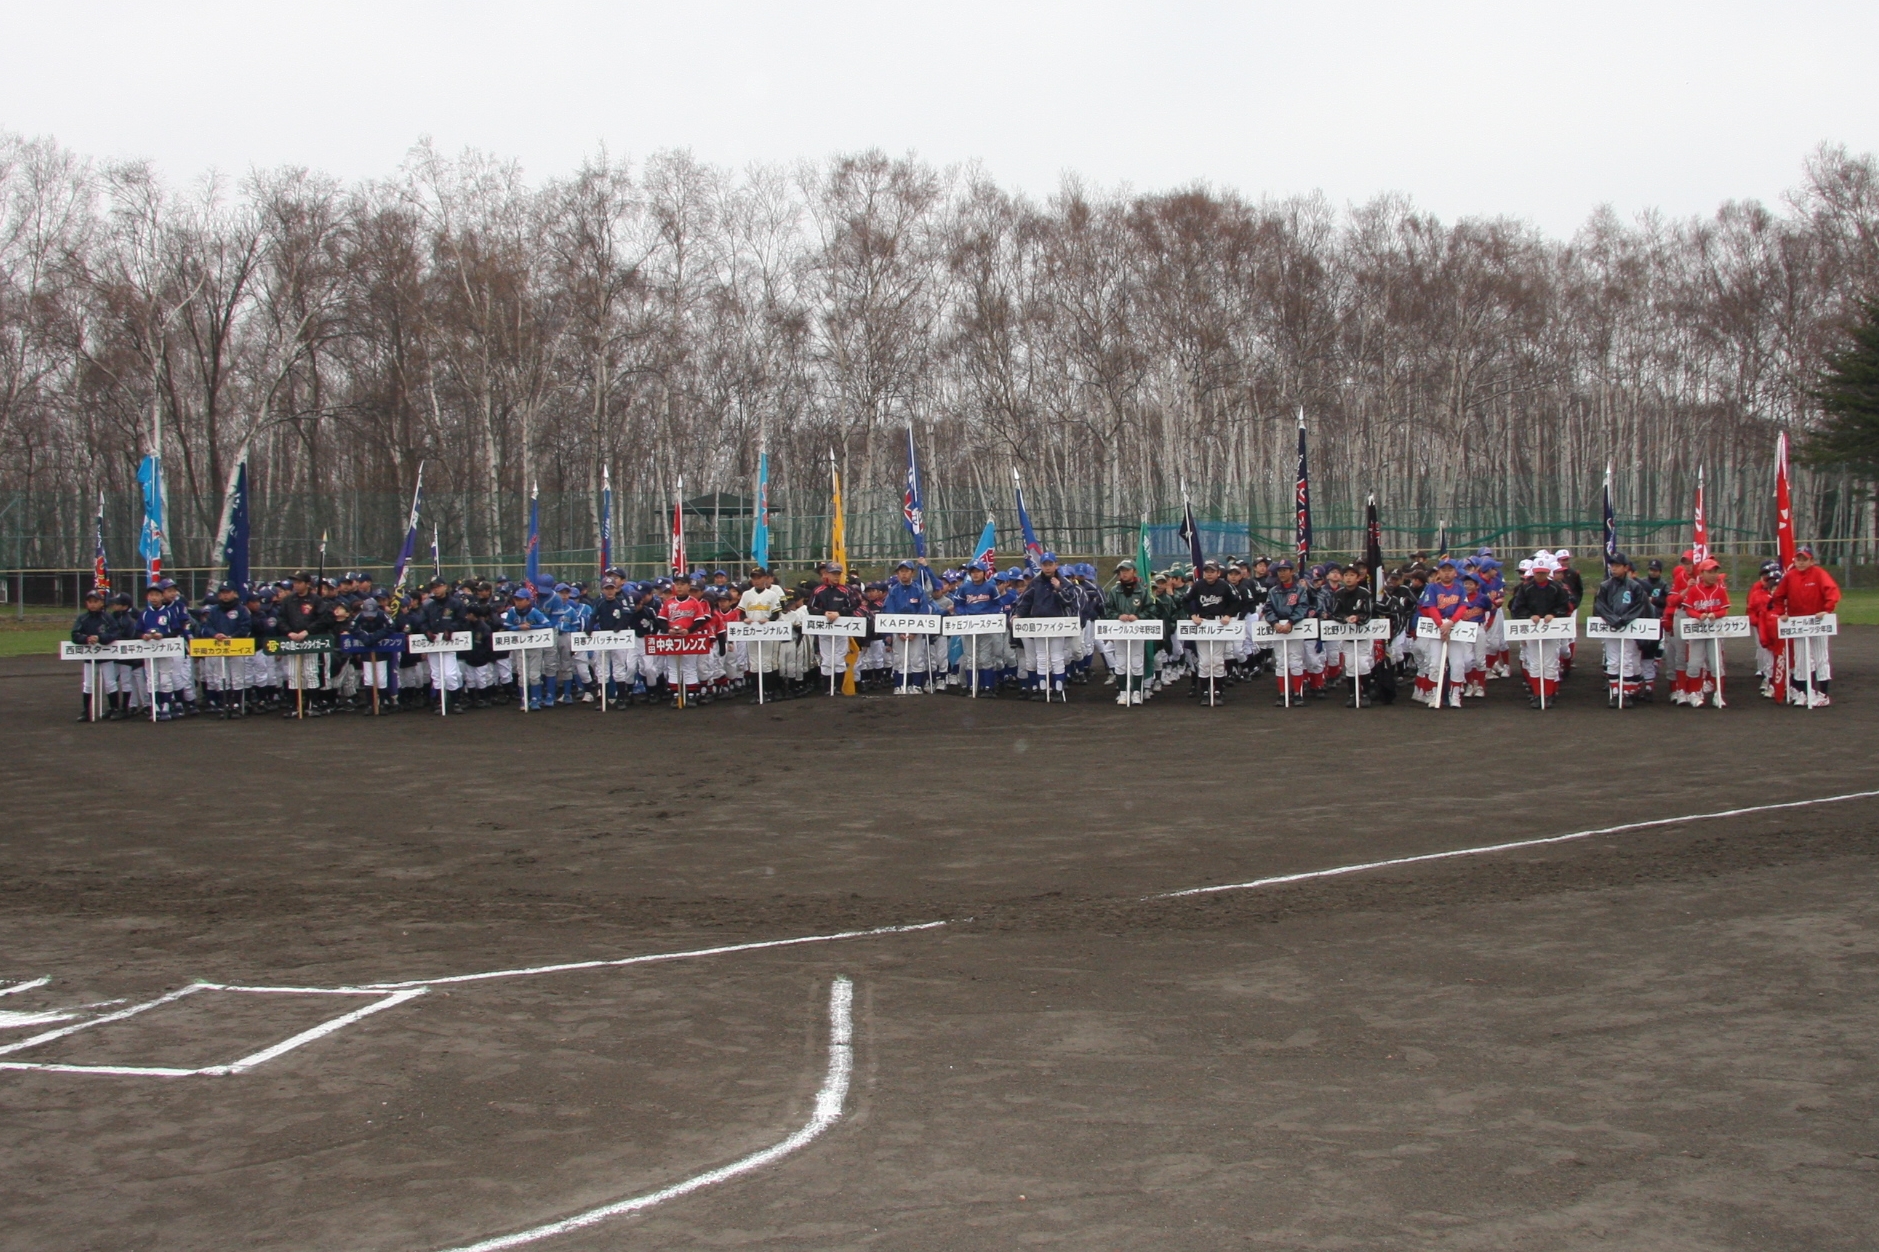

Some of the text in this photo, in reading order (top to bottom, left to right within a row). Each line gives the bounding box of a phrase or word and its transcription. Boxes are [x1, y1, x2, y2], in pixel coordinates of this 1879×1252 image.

[1622, 590, 1631, 604] S
[1014, 621, 1078, 632] 中の島ファイターズ
[1180, 625, 1243, 635] 西岡ボルテージ
[1256, 623, 1313, 636] 北野ーズ
[1509, 621, 1571, 635] 月寒スターズ
[656, 637, 707, 652] 中央フレンズ
